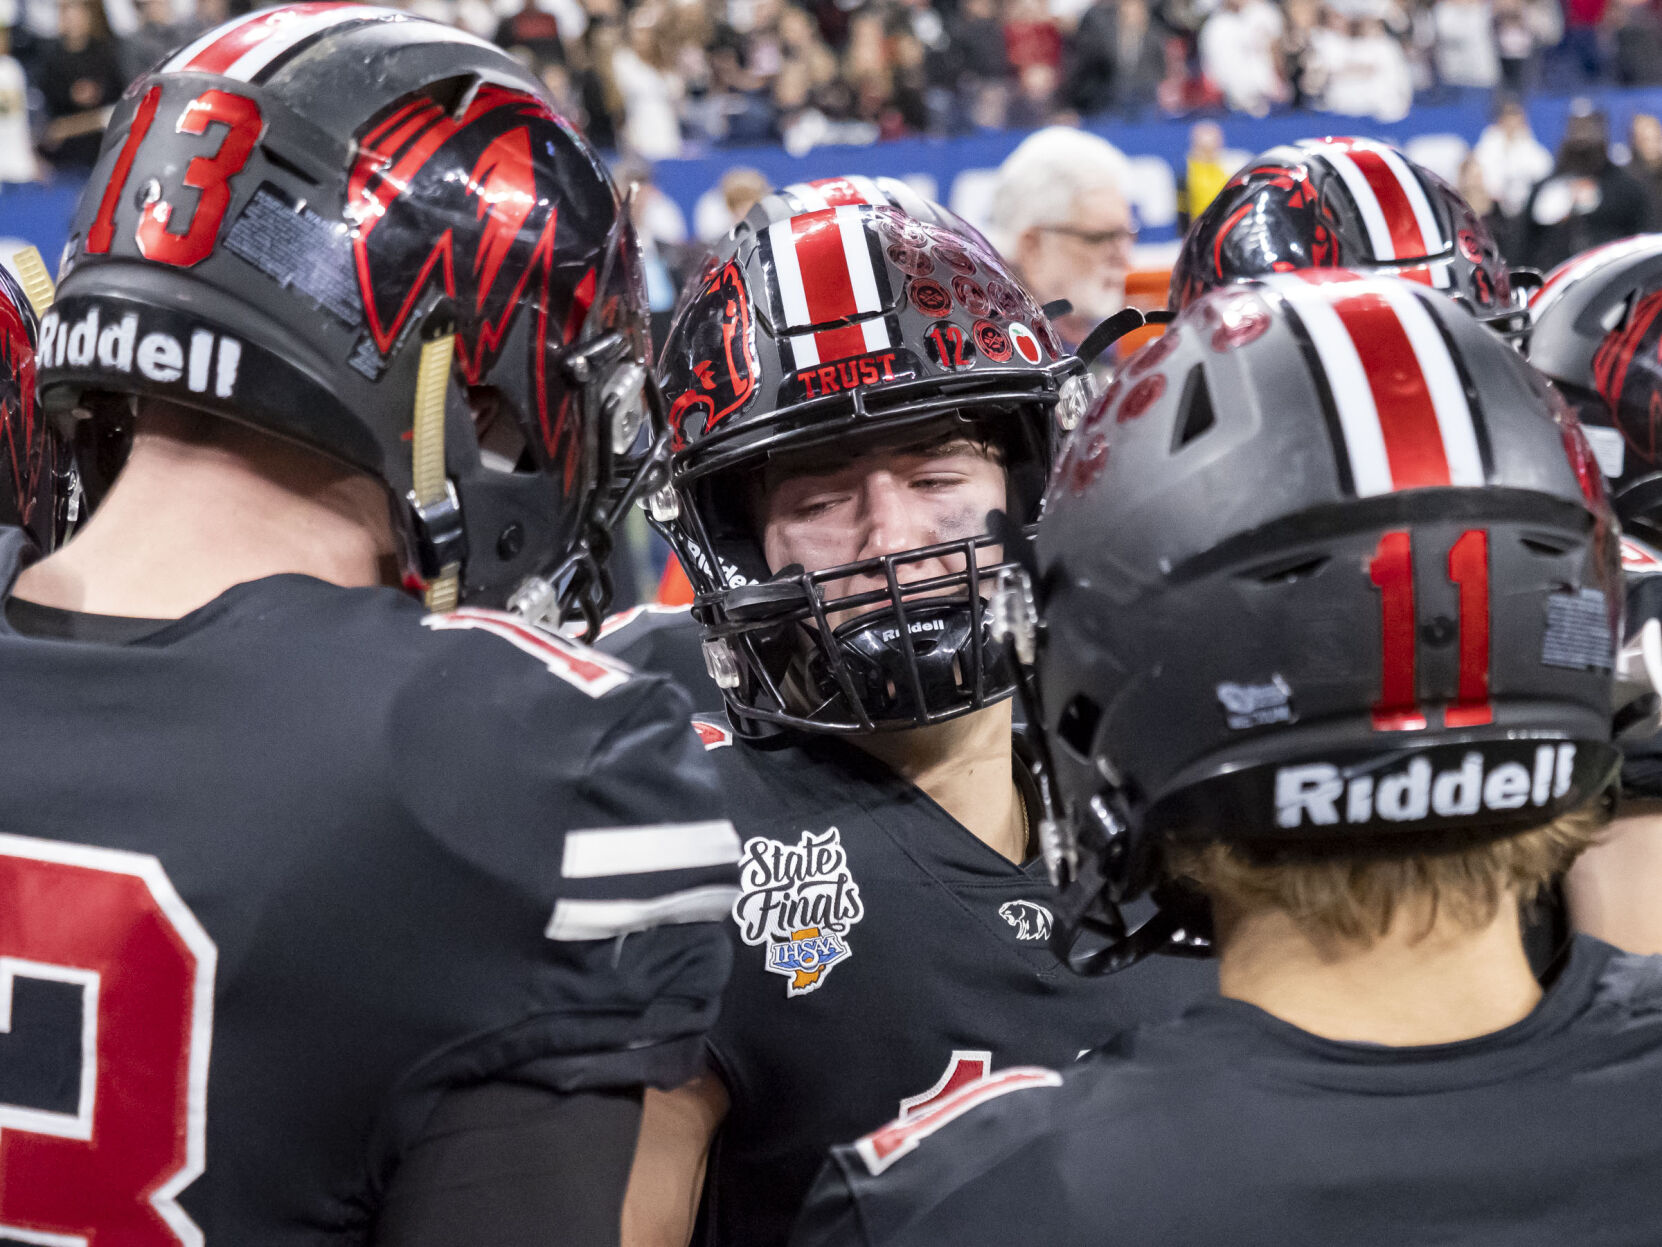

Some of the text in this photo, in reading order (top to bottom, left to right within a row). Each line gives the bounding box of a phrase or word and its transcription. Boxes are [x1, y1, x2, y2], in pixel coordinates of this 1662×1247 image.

[87, 85, 265, 267] 13
[35, 305, 242, 398] Riddell
[797, 353, 896, 399] TRUST
[928, 326, 971, 367] 12
[882, 619, 945, 642] Ridell
[1368, 529, 1493, 731] 11
[1274, 742, 1577, 828] Riddell
[738, 830, 843, 888] State
[737, 873, 860, 941] Finals
[773, 934, 845, 968] IHSAA
